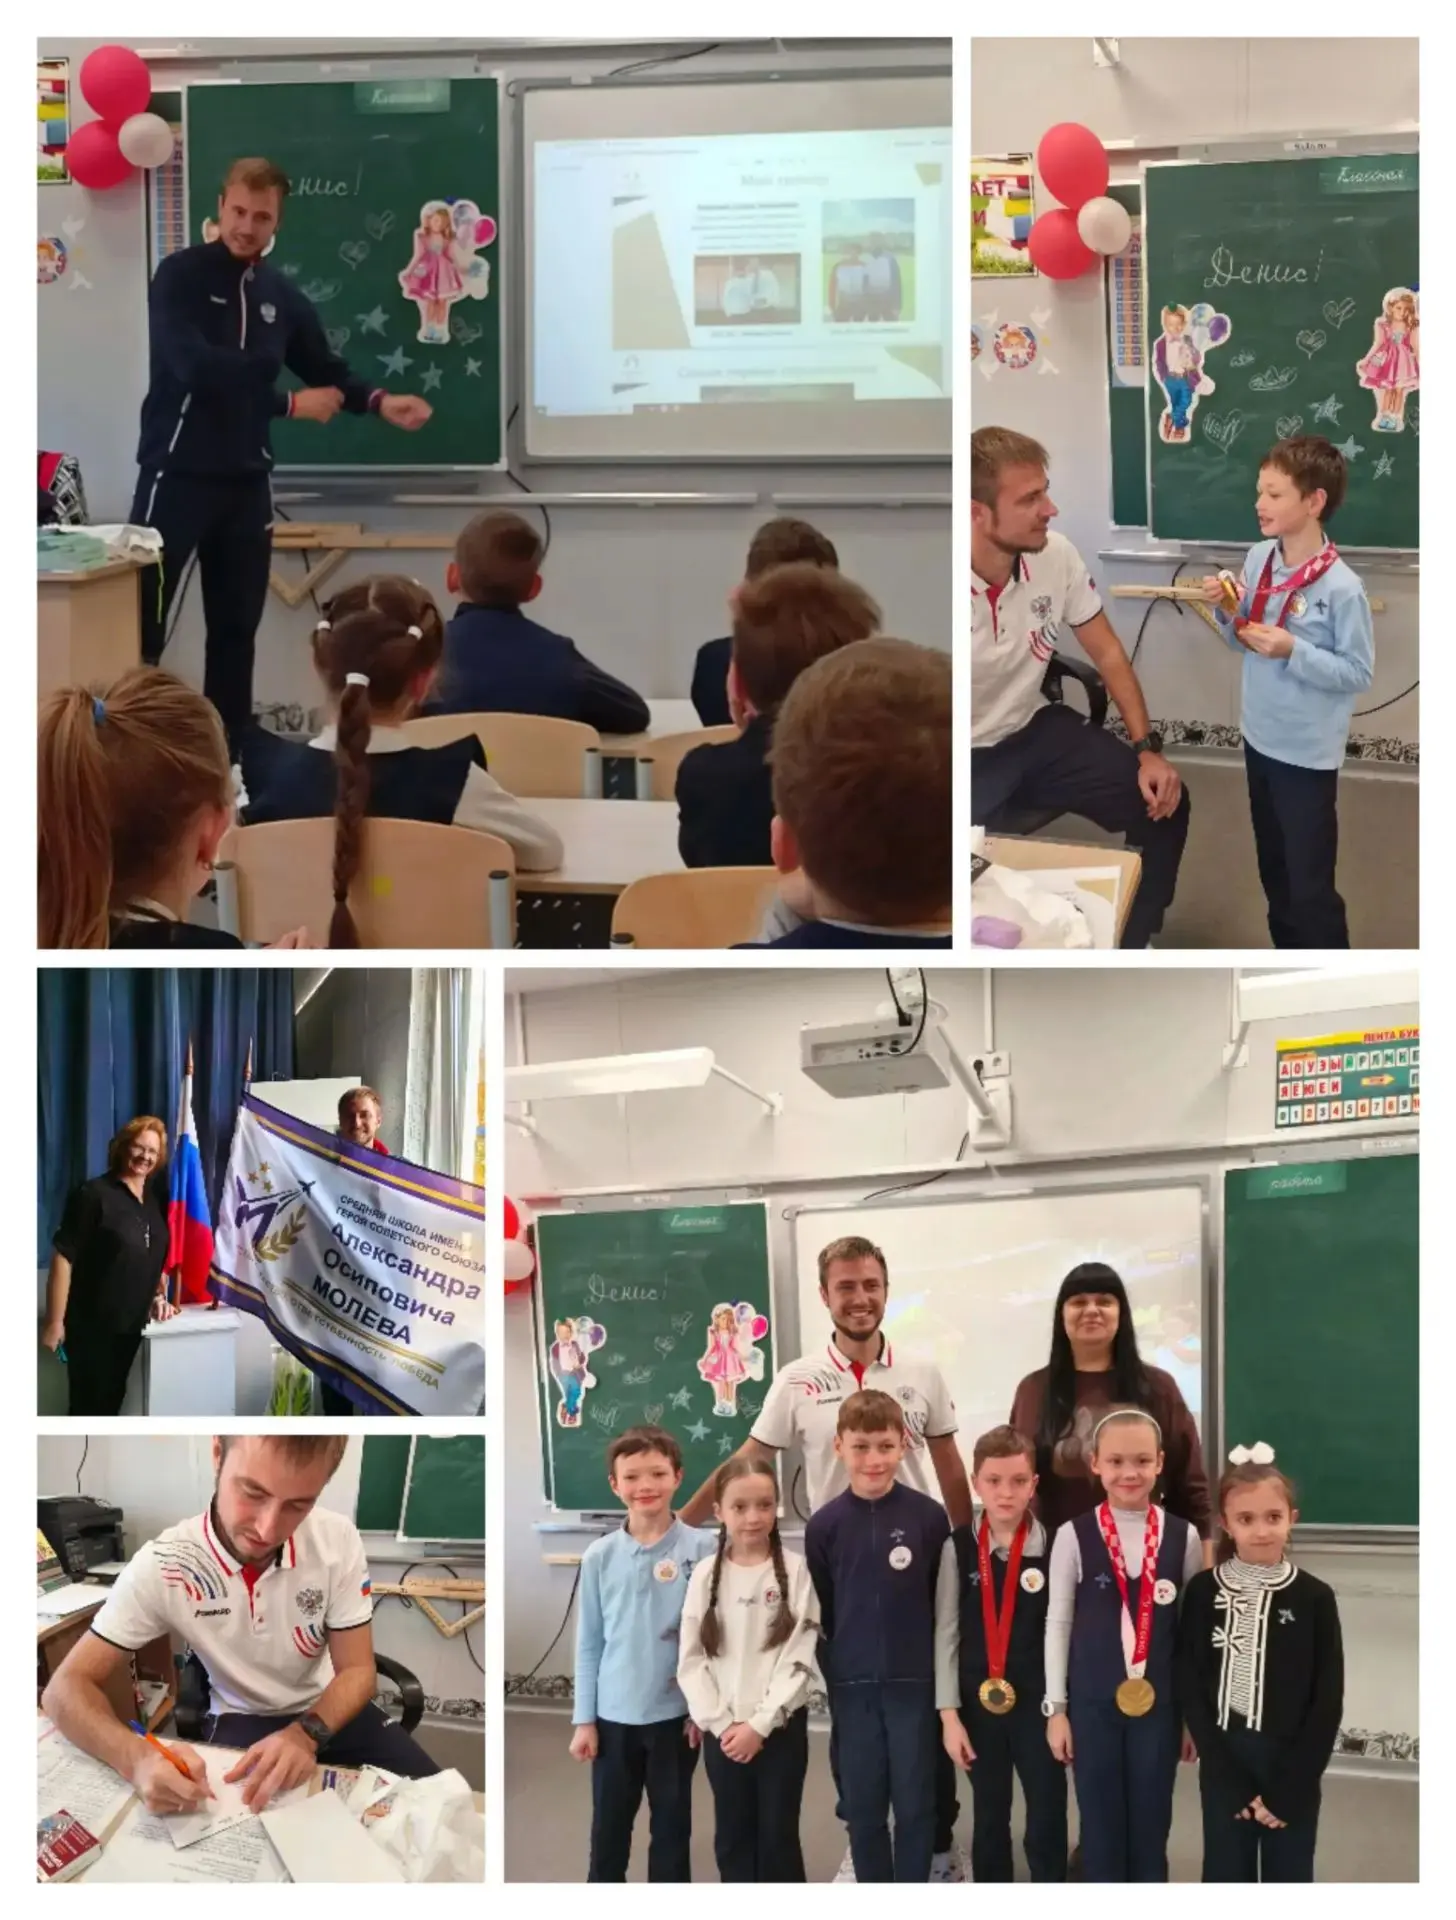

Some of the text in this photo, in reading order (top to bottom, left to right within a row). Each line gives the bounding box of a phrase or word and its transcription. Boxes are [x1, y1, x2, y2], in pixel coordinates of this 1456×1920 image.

[1203, 242, 1326, 288] Денис!
[332, 1222, 481, 1301] Александра
[336, 1206, 368, 1227] ГЕРОЯ
[369, 1220, 441, 1257] СОВЕТСКОГО
[388, 1215, 427, 1237] ШКОЛА
[429, 1231, 472, 1252] ИМЕН
[313, 1274, 411, 1345] МОЛЕВА
[323, 1248, 456, 1326] Осиповича
